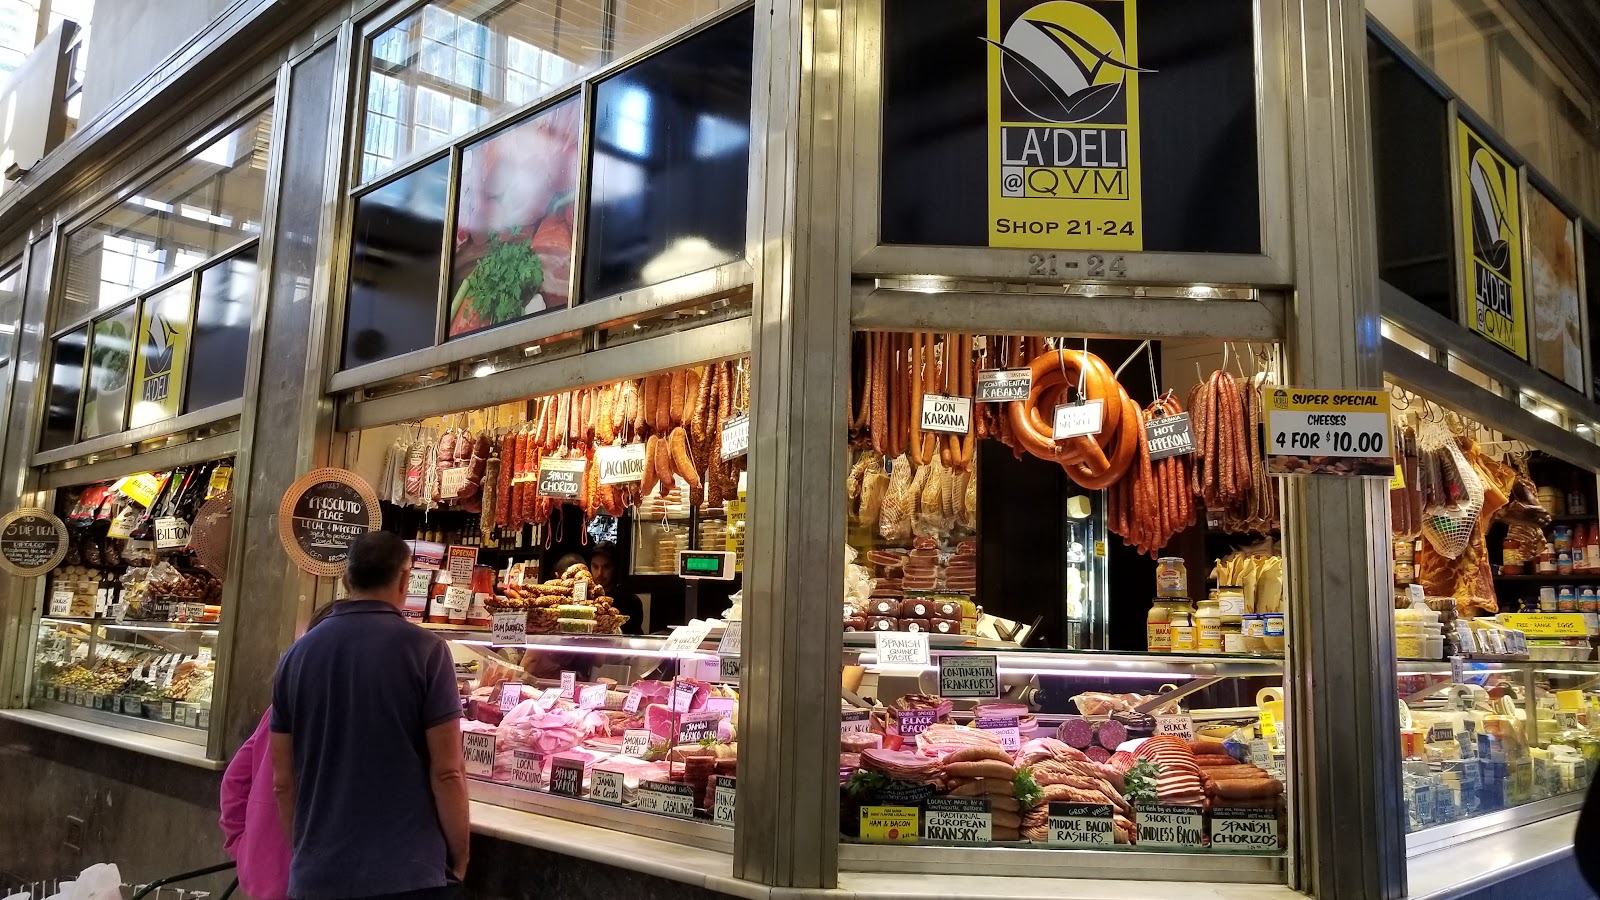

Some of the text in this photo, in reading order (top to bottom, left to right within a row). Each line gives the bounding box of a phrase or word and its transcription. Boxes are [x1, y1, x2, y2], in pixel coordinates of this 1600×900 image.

[1002, 127, 1126, 167] LA'DELI
[1066, 219, 1134, 236] 21-24
[982, 387, 1023, 398] KABANA
[1292, 394, 1379, 406] SUPER SPECIAL
[934, 402, 956, 413] DON
[924, 411, 965, 426] KABANA
[1307, 415, 1347, 426] CHEESES
[1153, 424, 1175, 436] HOT
[1147, 432, 1191, 451] EPPERONI
[1276, 430, 1384, 453] 4 FOR $10.00
[547, 470, 575, 481] SPANISH
[540, 481, 578, 492] CHORIZO
[318, 508, 344, 521] PLACE
[7, 523, 17, 536] 3
[37, 526, 58, 536] DEAL
[301, 519, 325, 531] LOCAL
[451, 548, 475, 558] SPECIAL
[881, 638, 920, 648] SPANISH
[942, 667, 994, 677] CONTINENTAL
[942, 677, 994, 690] FRANKFURTS
[901, 724, 928, 733] BACO
[467, 734, 489, 748] SHAVED
[623, 735, 648, 746] SMOKED
[516, 759, 535, 771] LOCAL
[555, 766, 578, 782] SPANISH
[592, 785, 619, 800] de Cerdo
[937, 812, 981, 820] TRADITIONAL
[1068, 805, 1110, 816] GREAT VALUE
[929, 817, 987, 829] EUROPEAN
[1144, 813, 1192, 825] SHORT-CUT
[1049, 818, 1113, 833] MIDDLE BACON
[1220, 820, 1272, 835] SPANISH
[928, 825, 978, 842] KRANSKY
[1057, 831, 1104, 844] RASHERS
[1136, 822, 1203, 845] RINDLESS BACON
[1212, 832, 1277, 846] CHORIZOS
